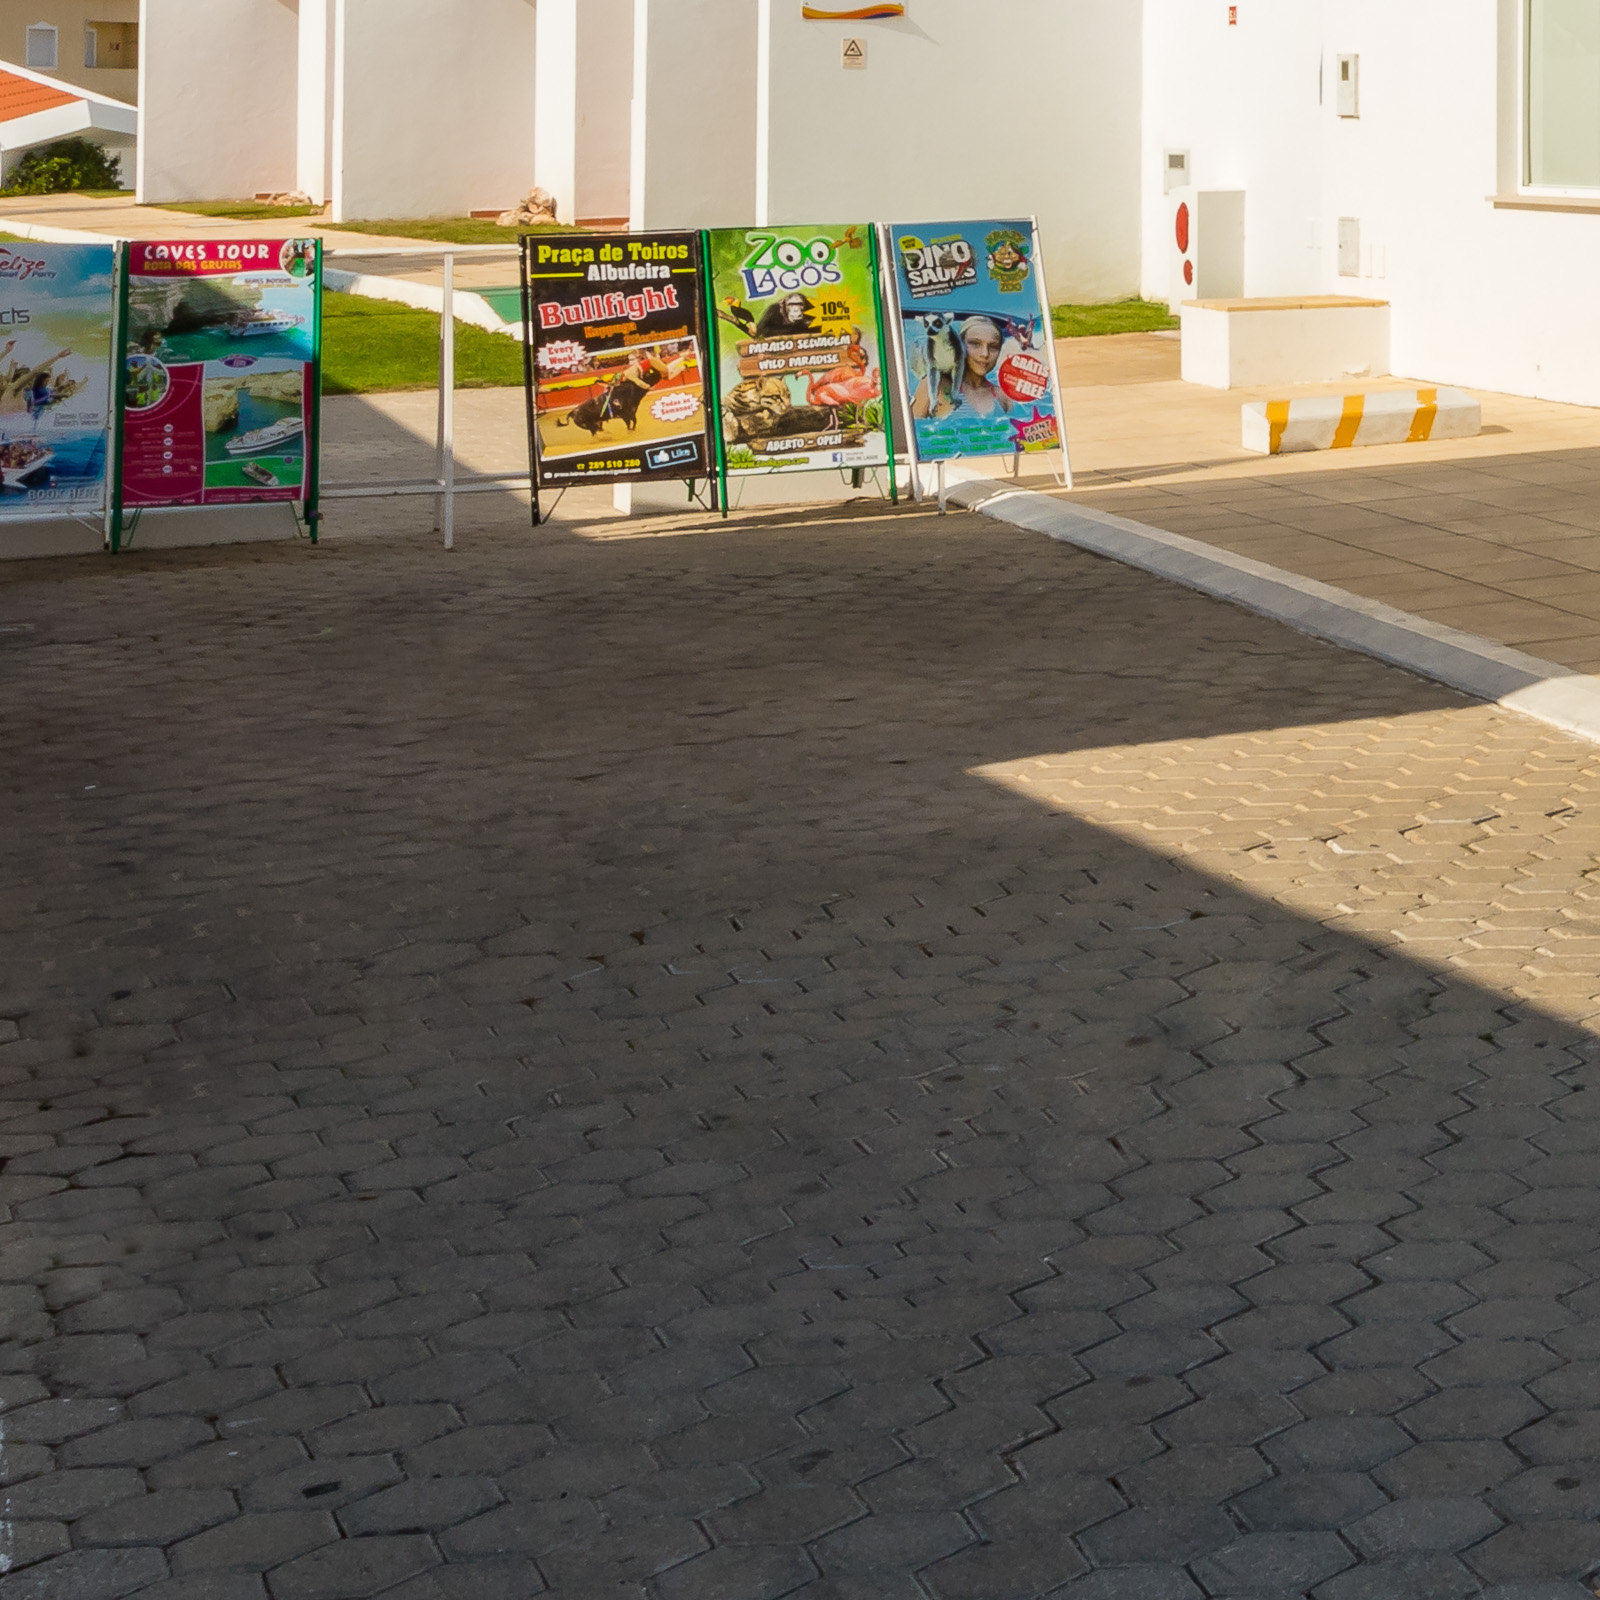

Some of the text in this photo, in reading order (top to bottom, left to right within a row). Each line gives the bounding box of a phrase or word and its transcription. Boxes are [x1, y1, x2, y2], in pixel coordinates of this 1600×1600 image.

[144, 244, 269, 260] CAVES TOUR
[537, 242, 688, 266] Praça de Toiros
[744, 233, 836, 271] ZOO
[0, 248, 46, 280] elize
[144, 260, 243, 271] ROTA DAS GRUTAS
[587, 262, 670, 281] Albufeira
[742, 263, 841, 299] LAGOS
[538, 284, 680, 329] Bullfight
[820, 300, 850, 315] 10%
[548, 346, 573, 356] Every
[758, 353, 840, 370] WILD PARADISE
[1011, 355, 1050, 378] GRÁTIS
[1015, 378, 1045, 399] FREE
[661, 400, 681, 408] Todas
[1023, 420, 1051, 435] PAINT
[1027, 430, 1054, 442] BALL
[766, 438, 805, 451] ABERTO
[816, 433, 842, 446] OPEN
[671, 448, 691, 459] Like
